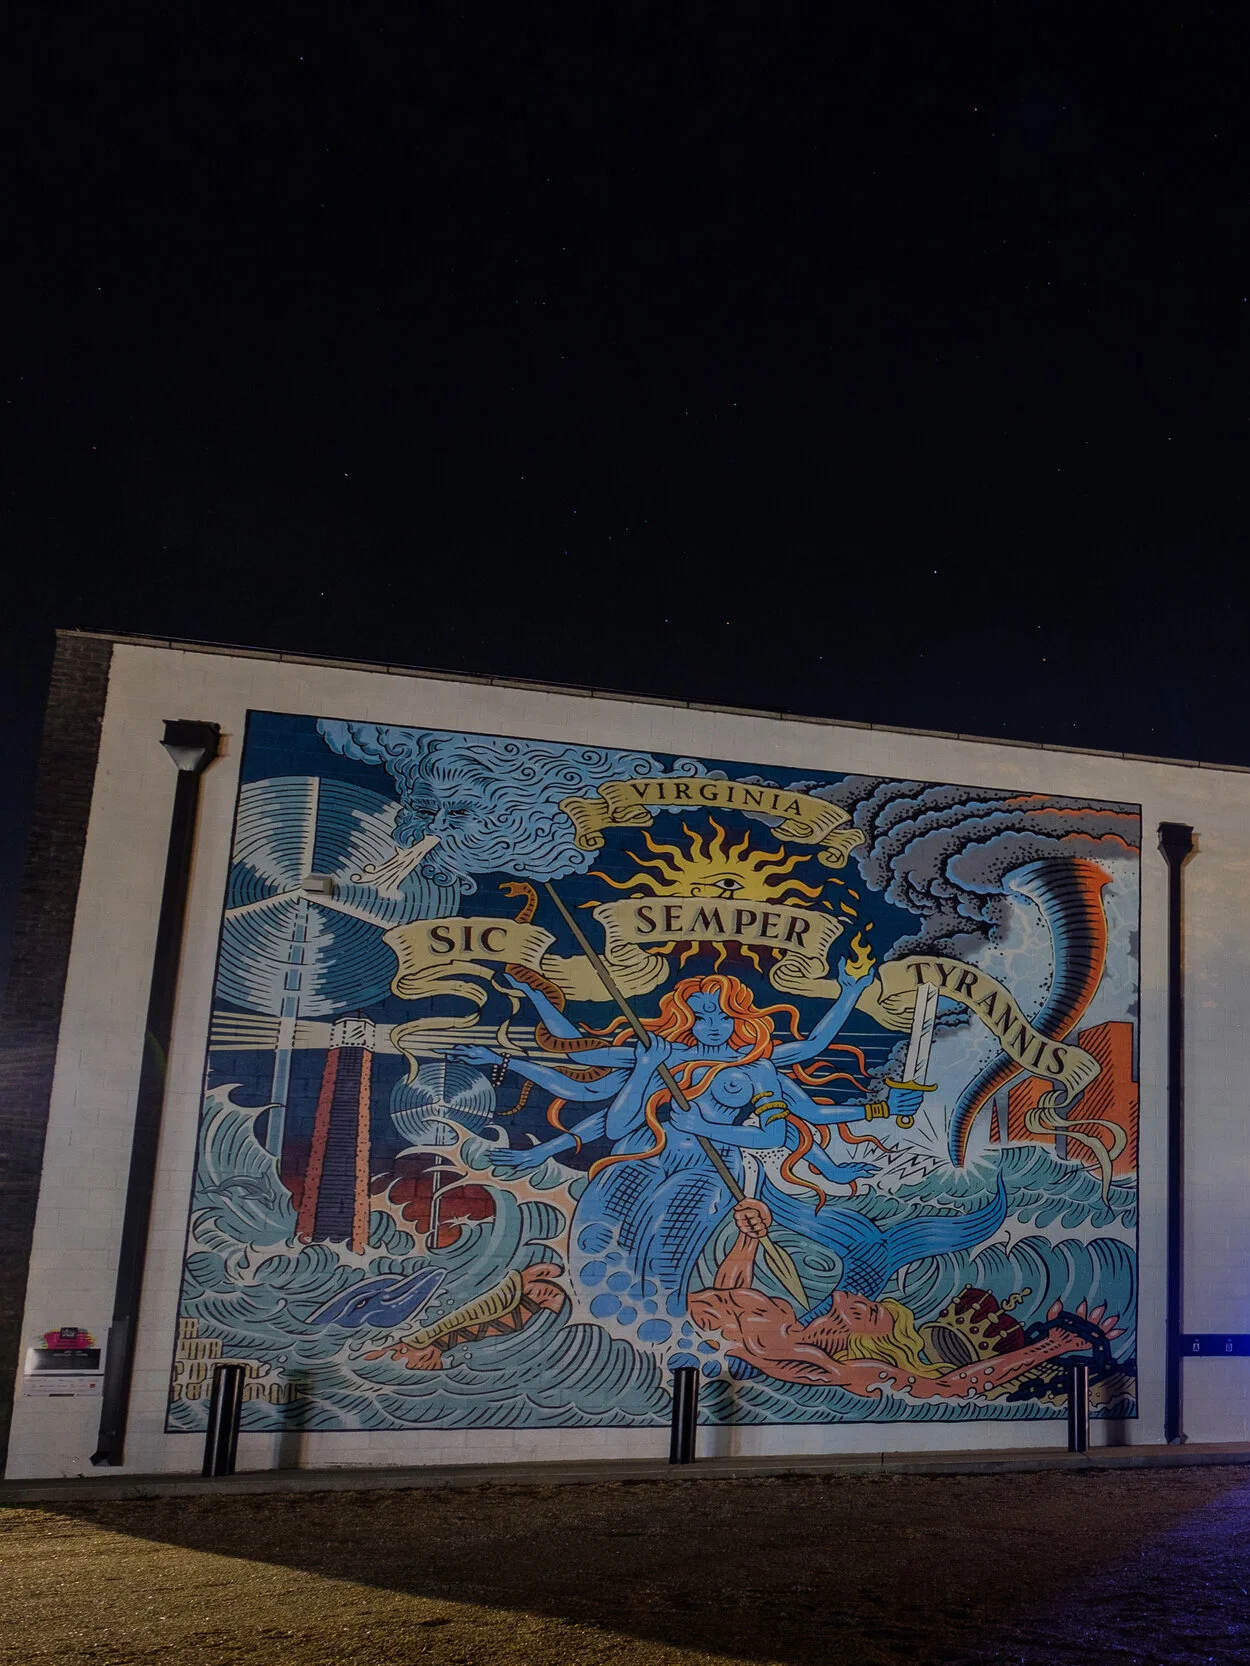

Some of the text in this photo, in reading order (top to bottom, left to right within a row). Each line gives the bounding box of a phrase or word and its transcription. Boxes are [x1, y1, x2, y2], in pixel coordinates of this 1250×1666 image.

[630, 782, 802, 816] VIRGINIA
[428, 905, 1068, 1075] SIC SEMPER TYRANNIS
